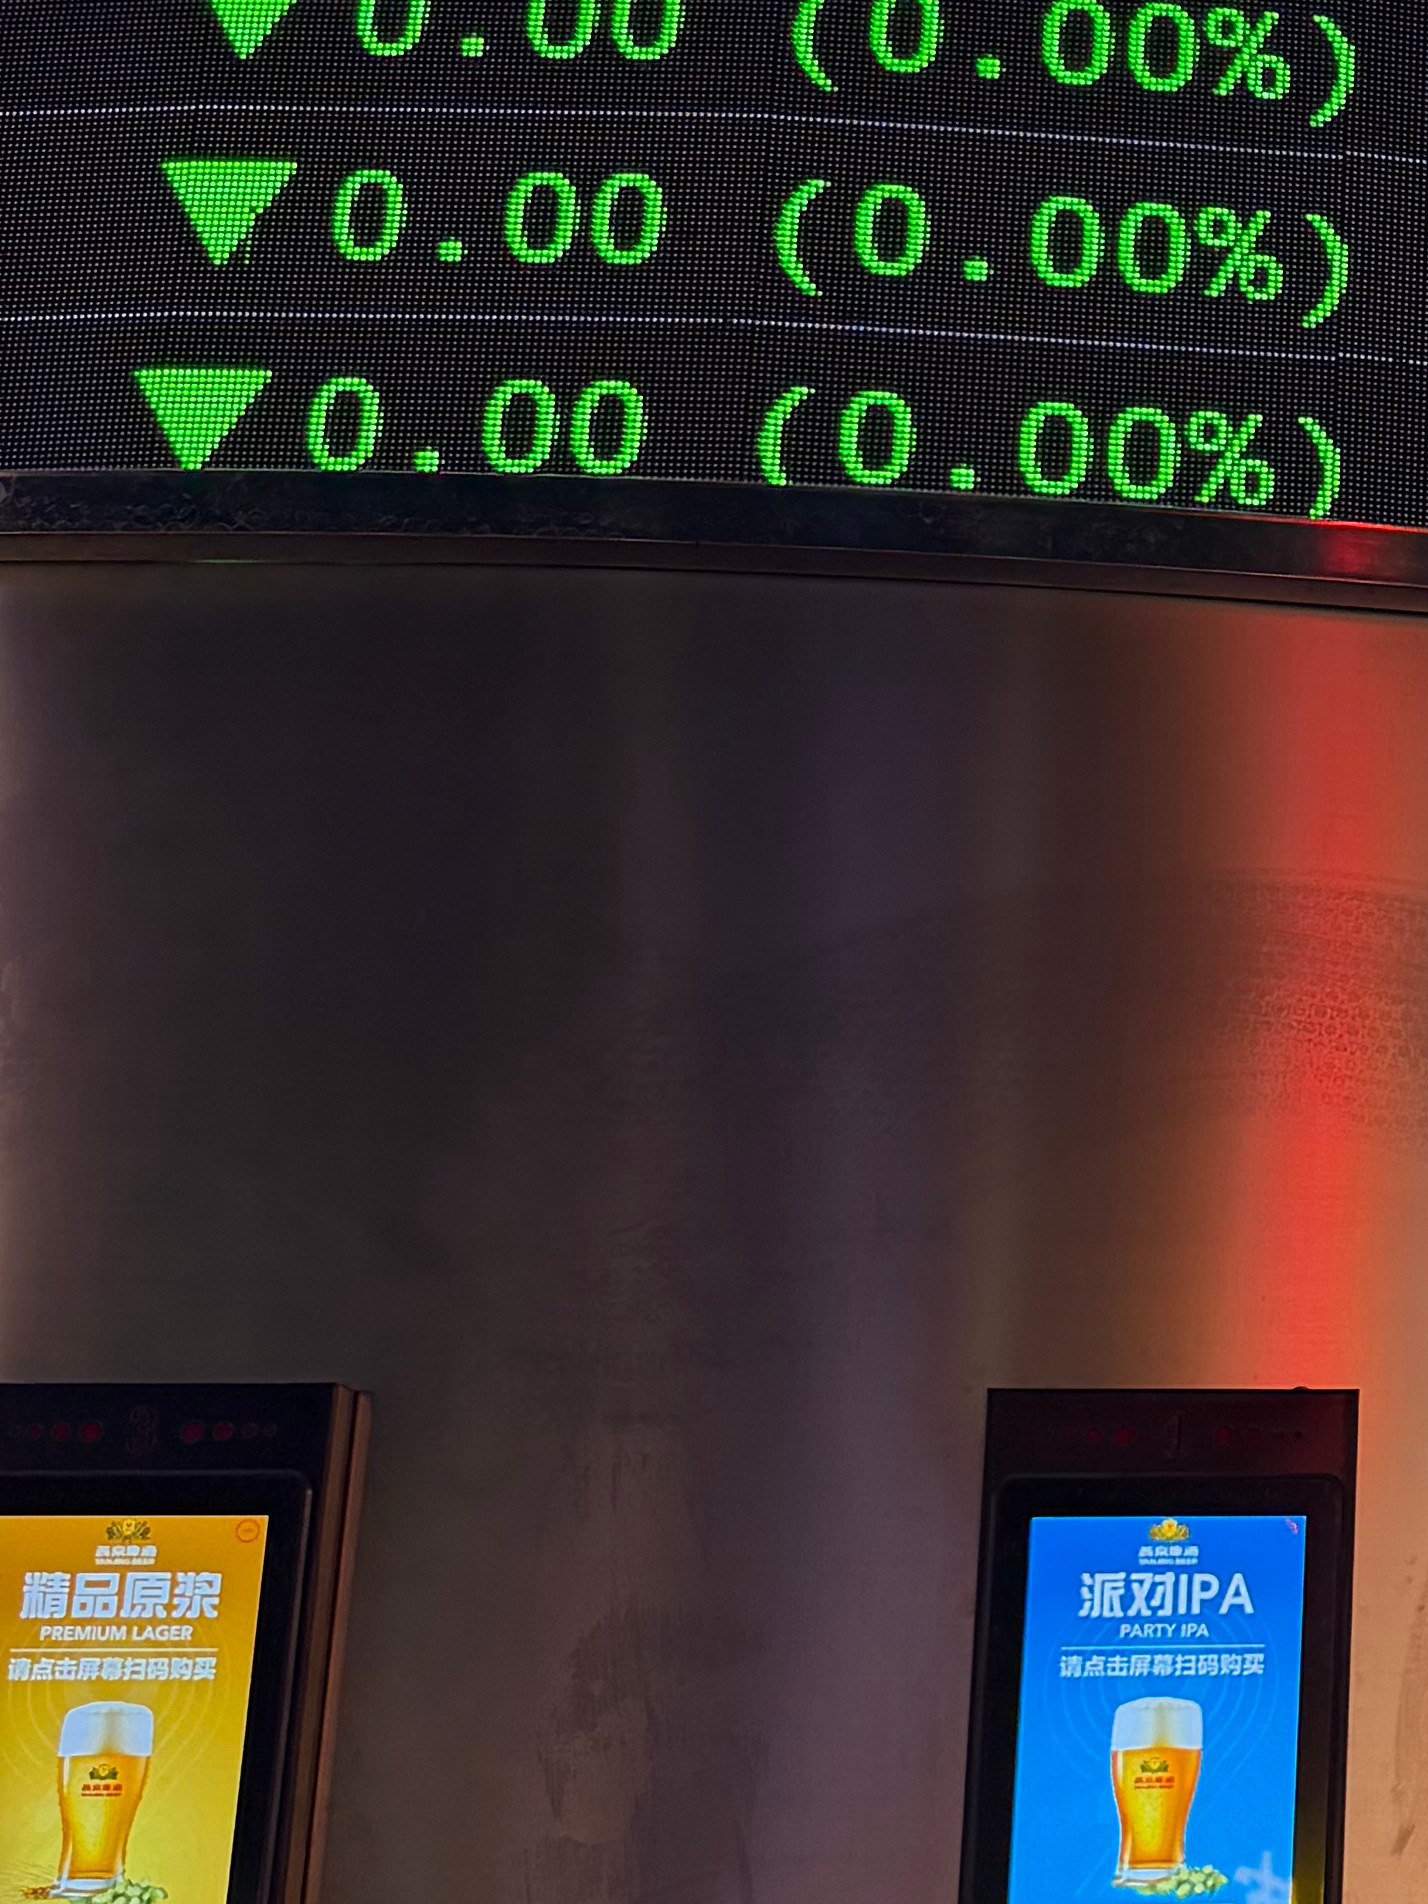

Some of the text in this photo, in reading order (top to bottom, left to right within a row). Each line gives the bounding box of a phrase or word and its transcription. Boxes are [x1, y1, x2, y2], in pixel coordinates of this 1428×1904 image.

[332, 168, 1349, 329] 0.00 (0.00%)
[306, 376, 1341, 520] 0.00 (0.00%)
[20, 1572, 222, 1619] 精品原浆
[1078, 1571, 1255, 1618] 派对IPA
[40, 1626, 193, 1641] PREMIUM LAGER
[1120, 1623, 1209, 1639] PARTY IPA
[8, 1657, 217, 1681] 请点击屏幕扫码购买
[1060, 1653, 1265, 1678] 请点击屏幕扫码购买
